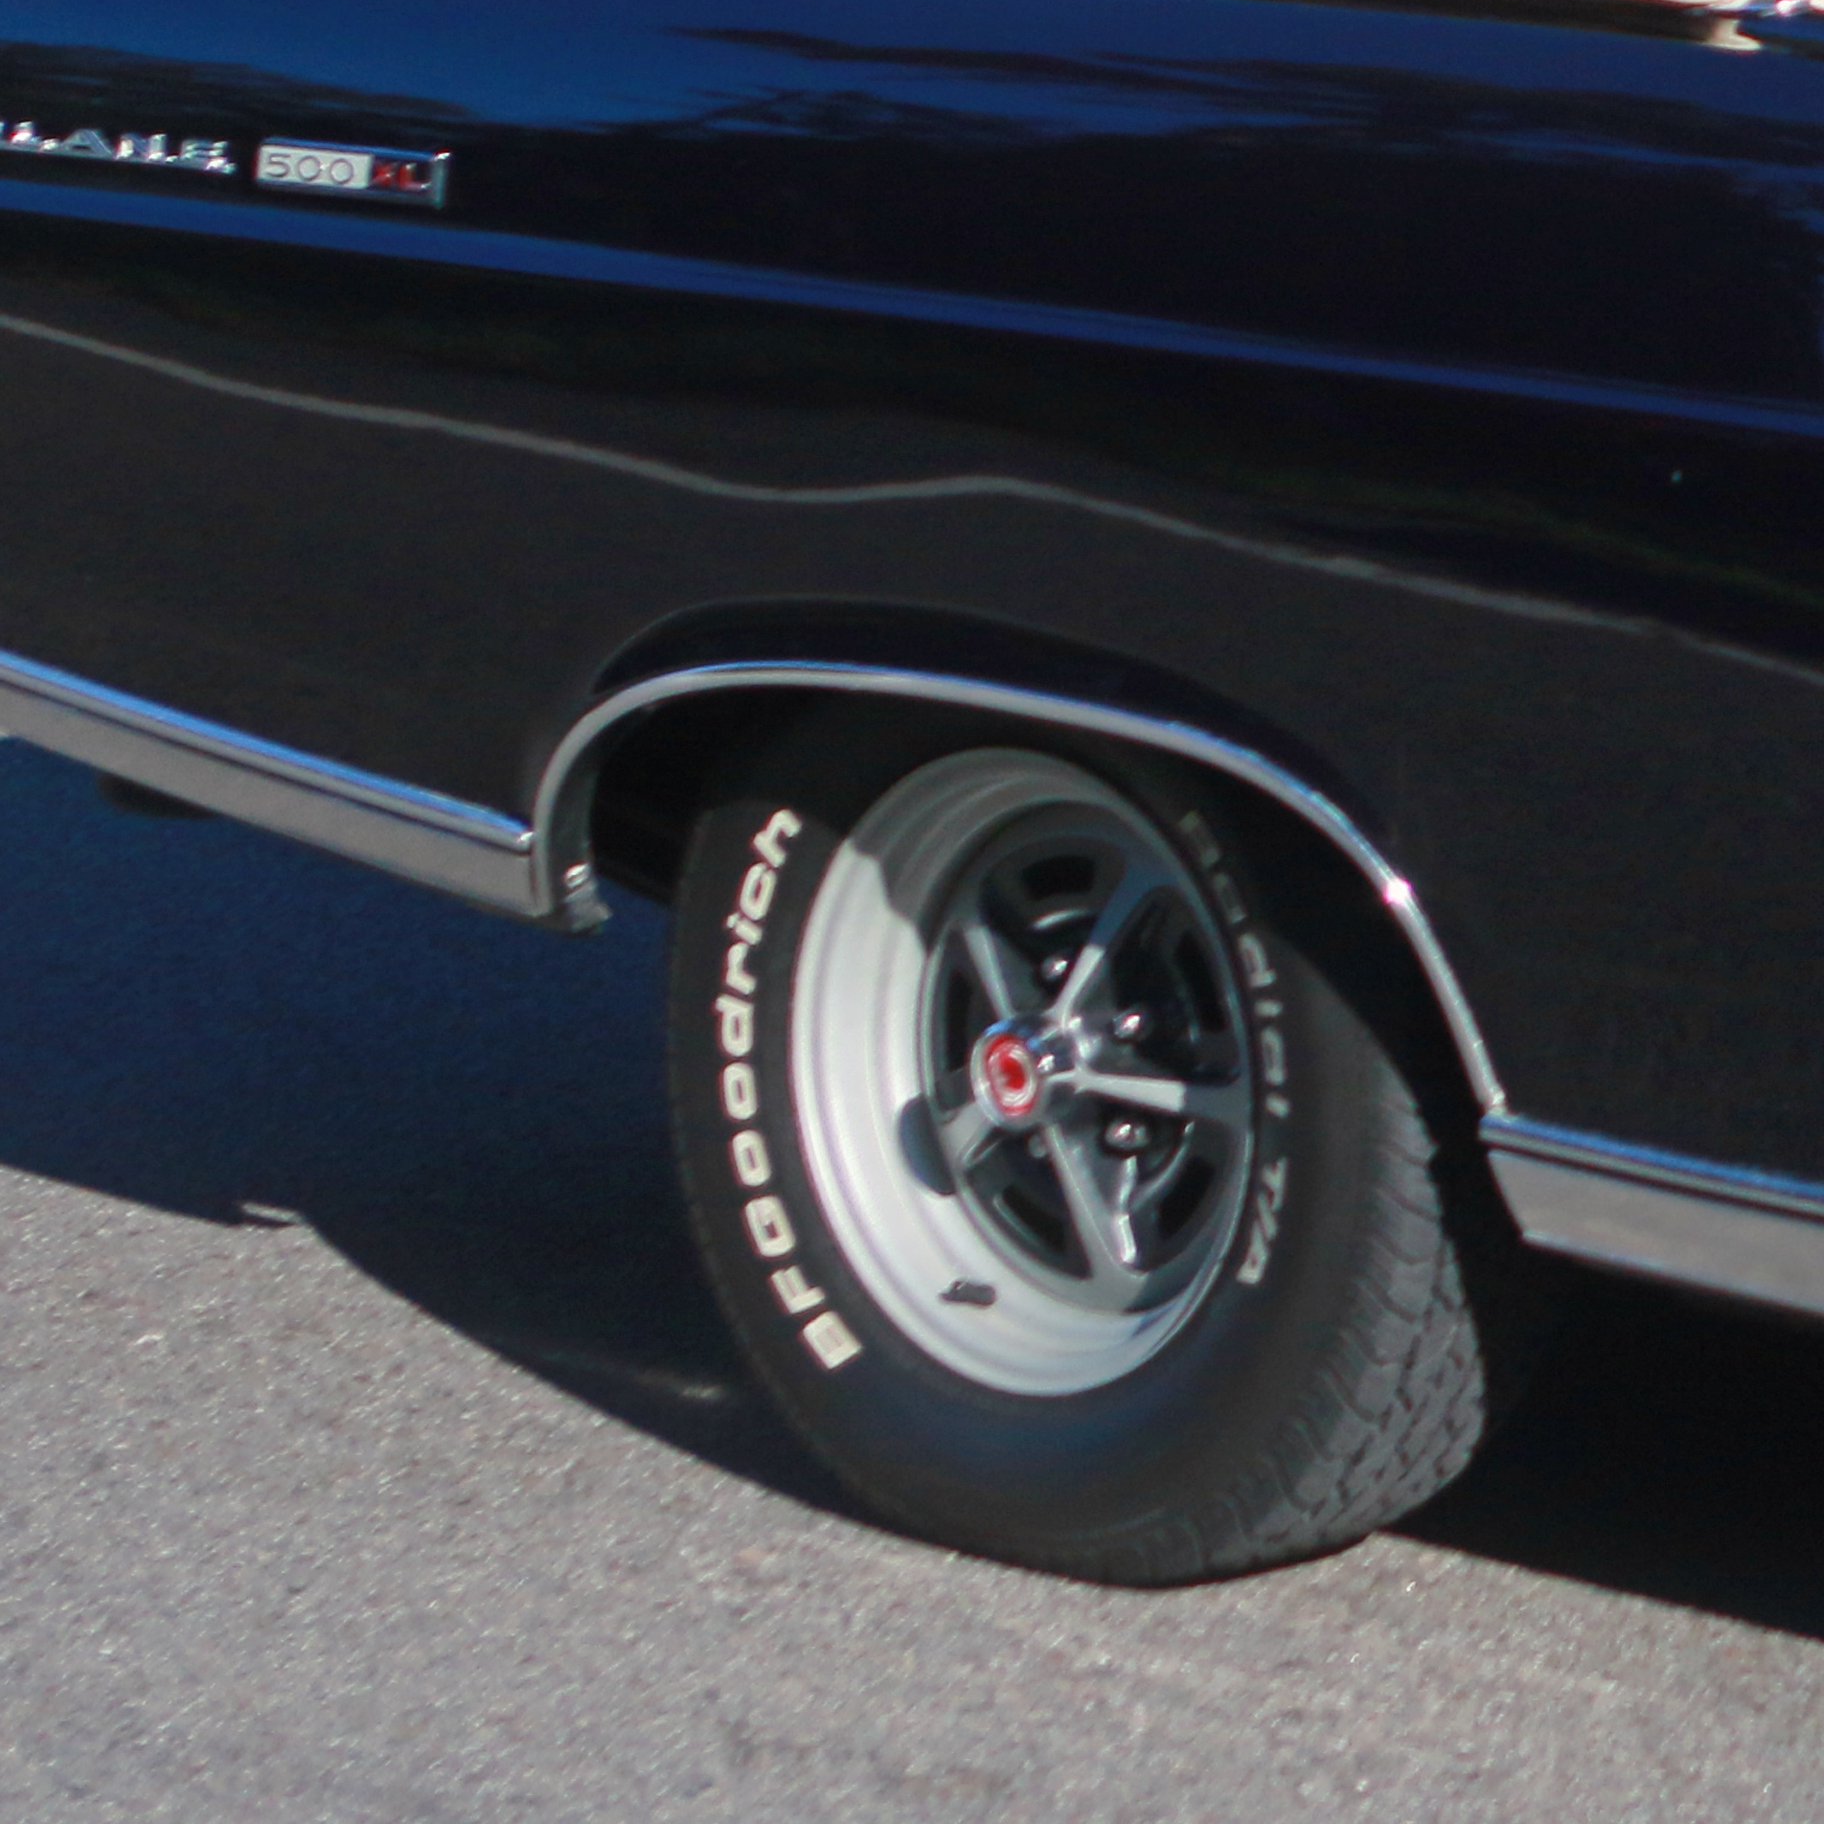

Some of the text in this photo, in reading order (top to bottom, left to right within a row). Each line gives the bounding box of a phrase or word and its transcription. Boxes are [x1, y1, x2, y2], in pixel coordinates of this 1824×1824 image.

[0, 121, 238, 174] LANE
[266, 152, 355, 185] 500
[714, 808, 863, 1370] BFGoodrich
